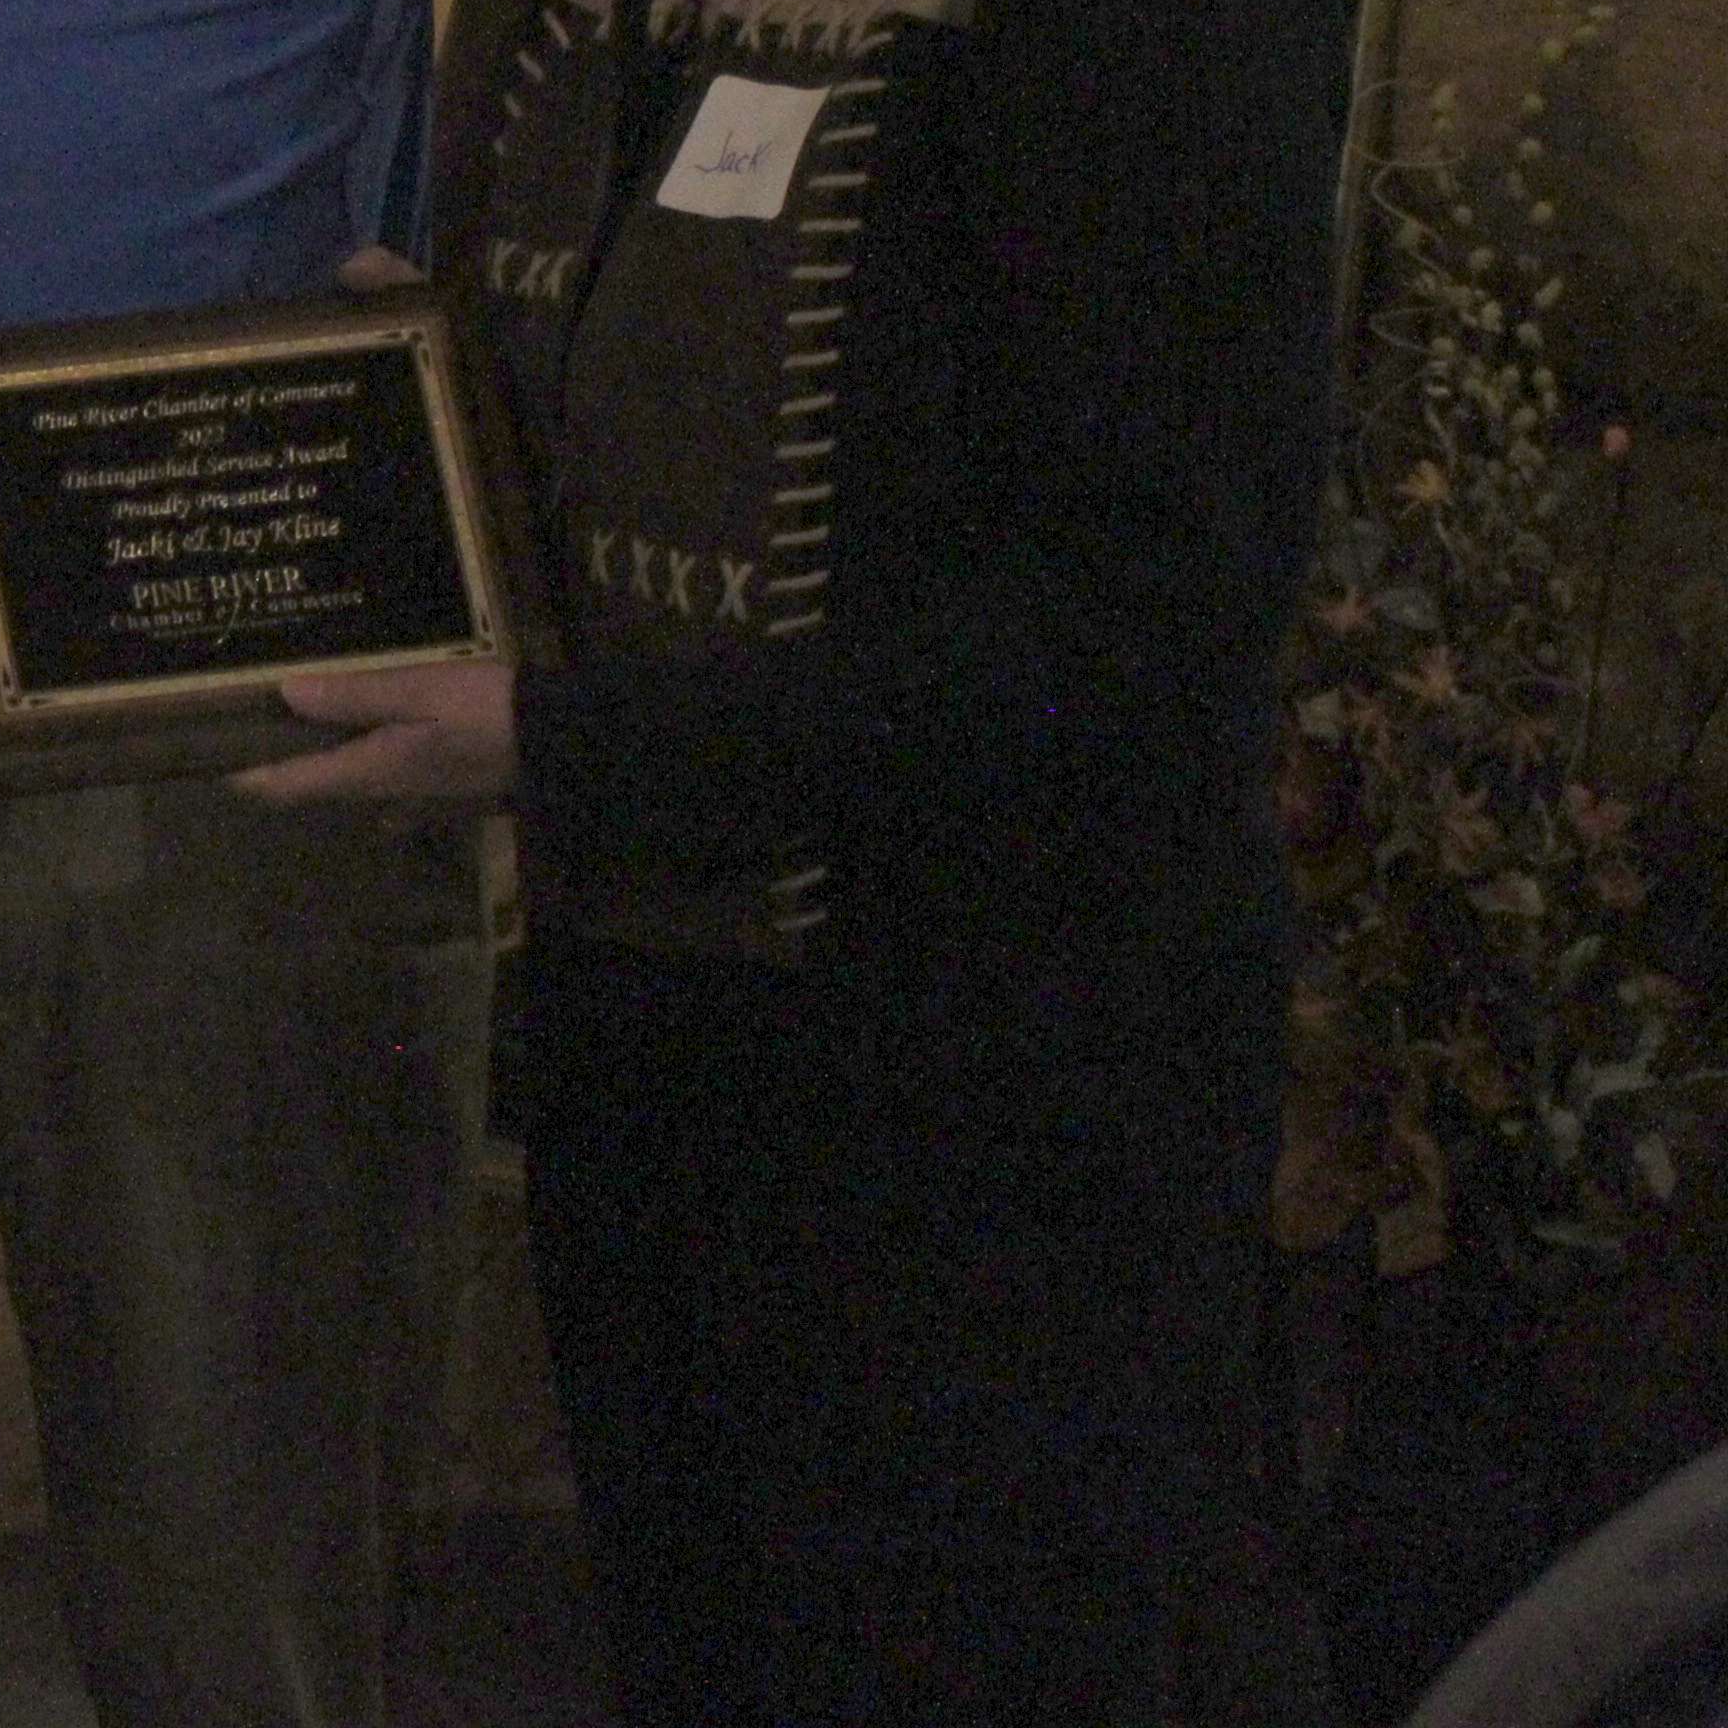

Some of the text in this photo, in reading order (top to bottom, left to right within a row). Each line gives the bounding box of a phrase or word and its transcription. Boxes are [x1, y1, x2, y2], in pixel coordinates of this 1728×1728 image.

[32, 380, 357, 432] Pine River Chamber of Commerce
[61, 438, 349, 490] Distinguished Service Award
[111, 481, 319, 521] Proudly Presented to
[106, 530, 176, 567] Jacki
[218, 524, 264, 554] Jay
[268, 513, 343, 544] Kline
[131, 566, 307, 610] PINE RIVER
